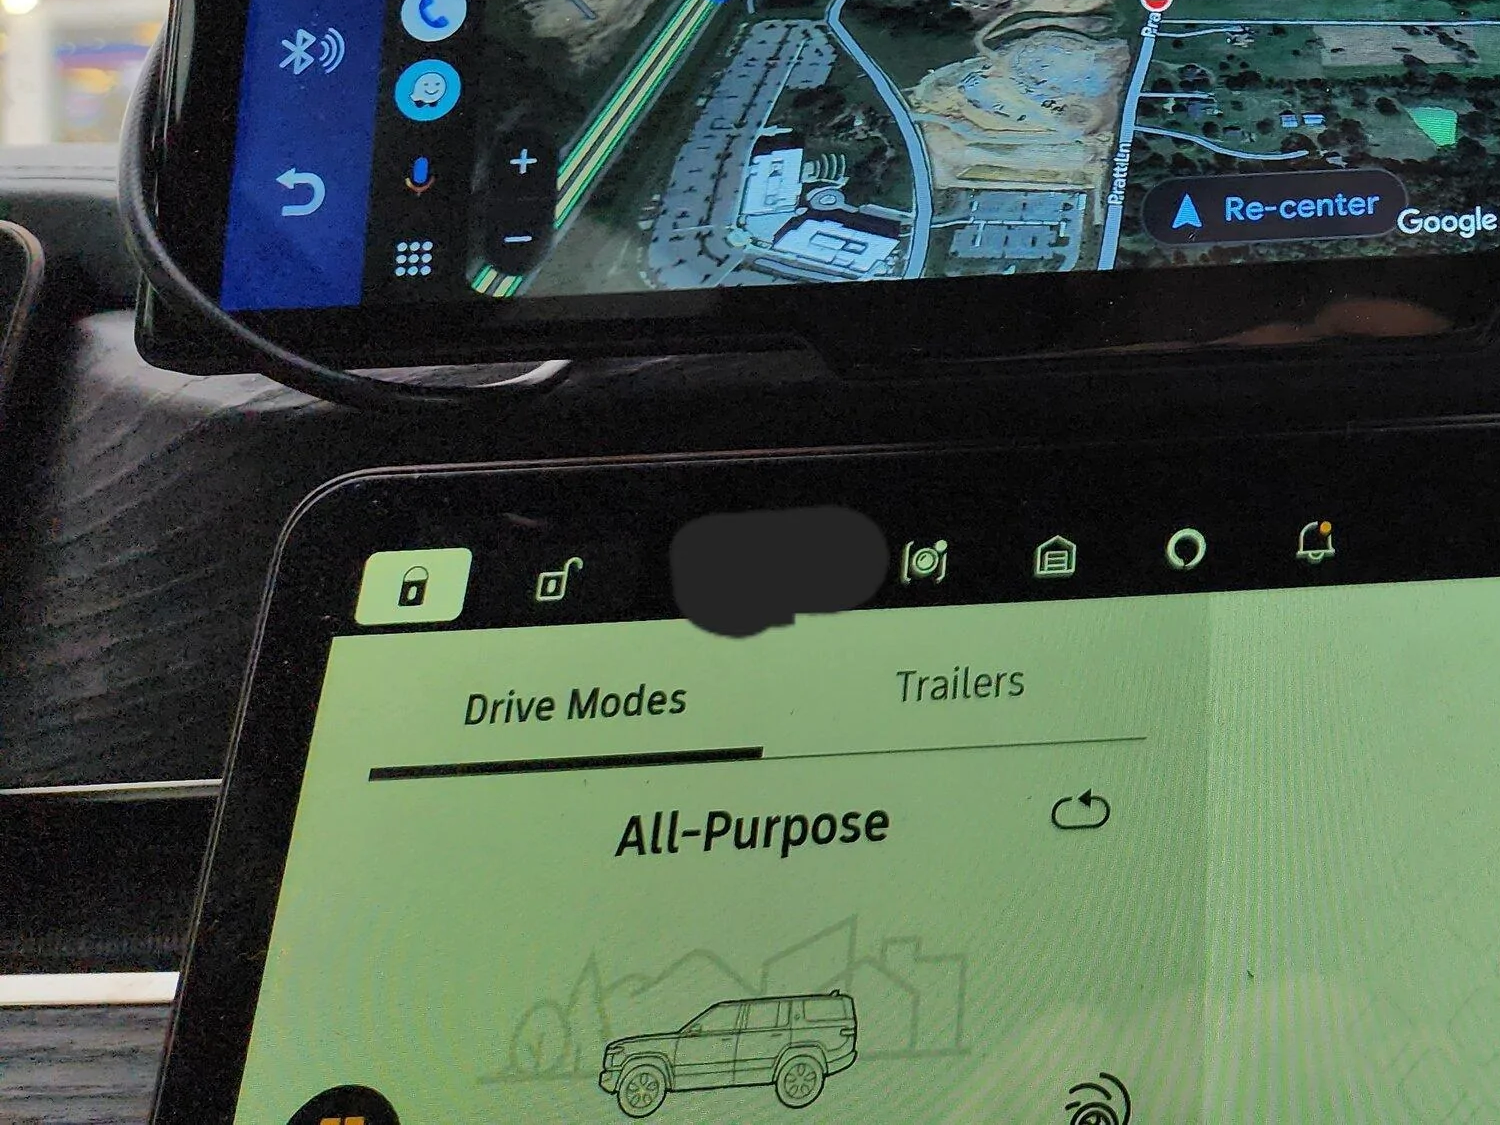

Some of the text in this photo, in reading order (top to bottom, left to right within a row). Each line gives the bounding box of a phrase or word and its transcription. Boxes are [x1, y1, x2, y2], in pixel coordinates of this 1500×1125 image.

[1108, 142, 1131, 204] Pratt Ln
[1225, 192, 1381, 223] Re-center
[1397, 205, 1498, 239] Google
[463, 682, 689, 727] Drive Modes
[896, 666, 1026, 704] Trailers
[614, 804, 892, 859] All-Purpose
